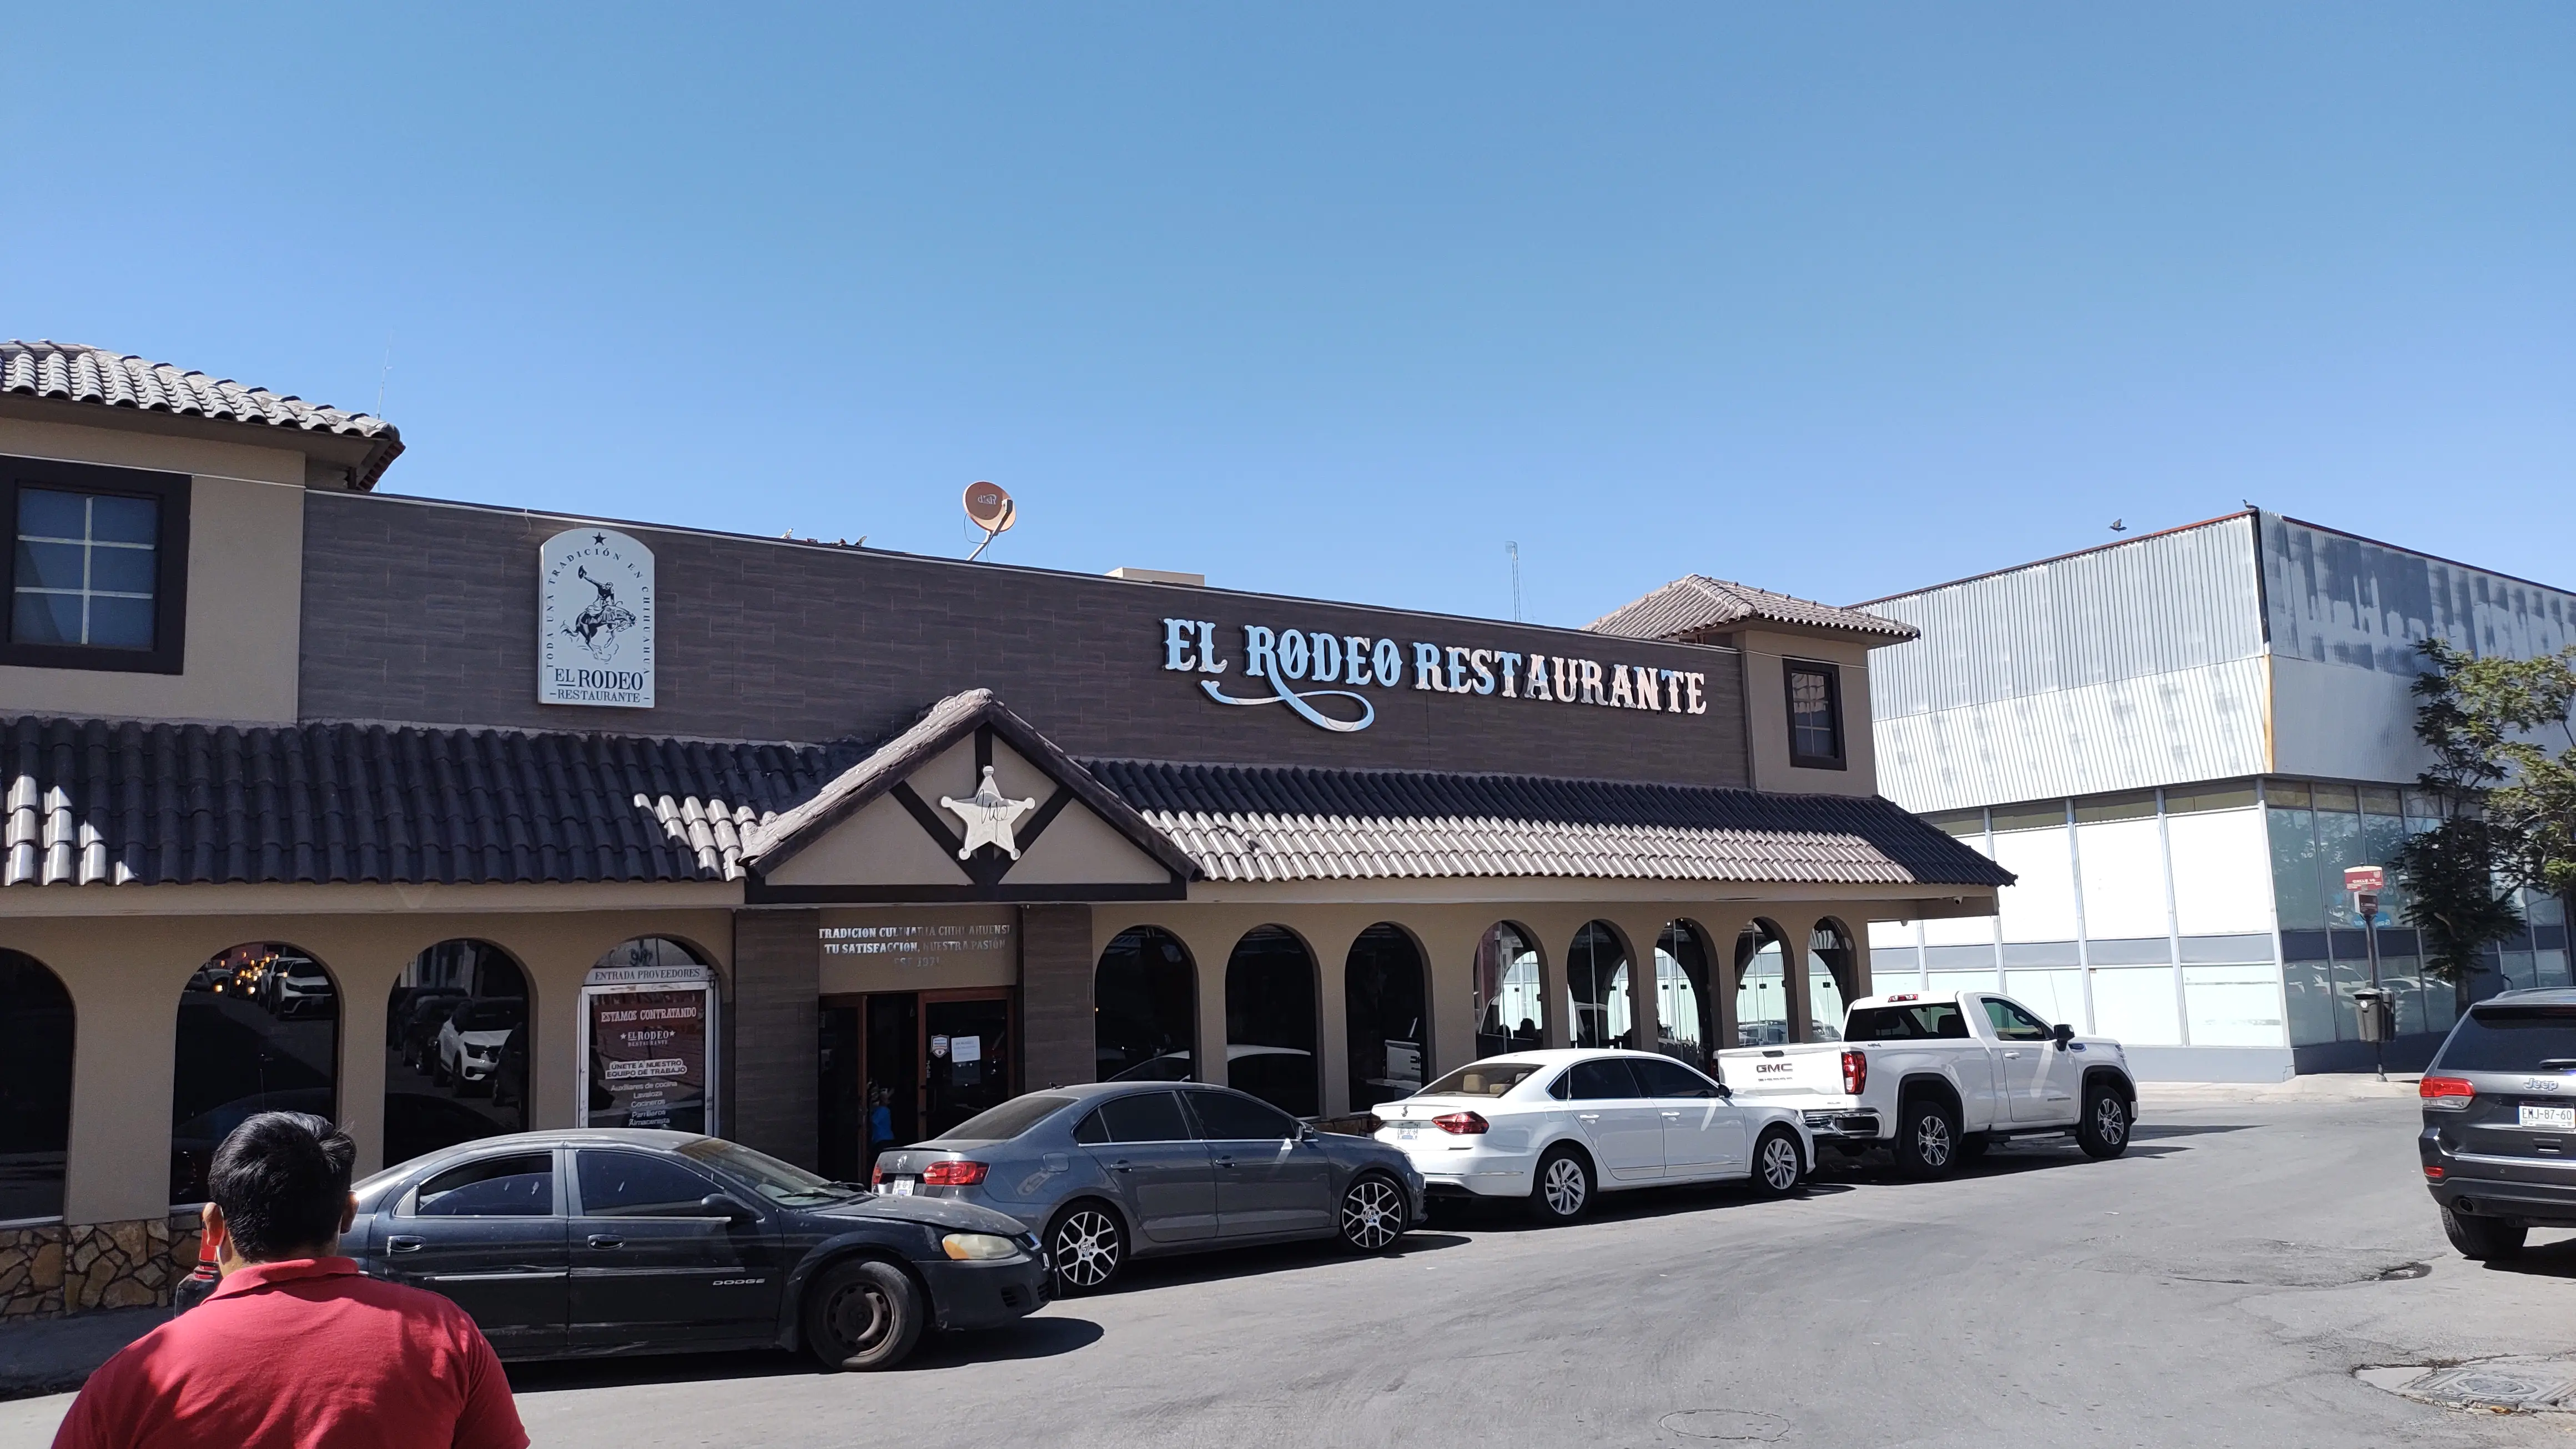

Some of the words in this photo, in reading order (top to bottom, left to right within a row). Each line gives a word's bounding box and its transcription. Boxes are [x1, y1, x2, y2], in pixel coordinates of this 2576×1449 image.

[547, 547, 622, 585] TRADICIÓN
[627, 562, 643, 578] EN
[546, 594, 555, 623] UNA
[641, 586, 651, 675] CHIHUAHUA
[546, 632, 555, 668] TODA
[1163, 618, 1228, 673] EL
[1412, 642, 1707, 715] RESTAURANTE
[555, 668, 575, 682] EL
[578, 669, 643, 691] RODEO
[557, 689, 640, 703] RESTAURANTE
[824, 944, 839, 954] TU
[923, 941, 967, 952] NUESTRA
[971, 938, 1005, 950] PASIÓN
[595, 970, 635, 980] ENTRADA
[637, 968, 701, 979] PROVEEDORES
[601, 1010, 637, 1022] ESTAMOS
[640, 1007, 697, 1020] CONTRATANDO
[628, 1032, 637, 1040] EL
[637, 1030, 669, 1040] RODEO
[646, 1060, 682, 1068] NUESTRO
[651, 1066, 686, 1075] TRABAJO
[1757, 1063, 1793, 1073] GMC
[2523, 1078, 2559, 1092] Jeep
